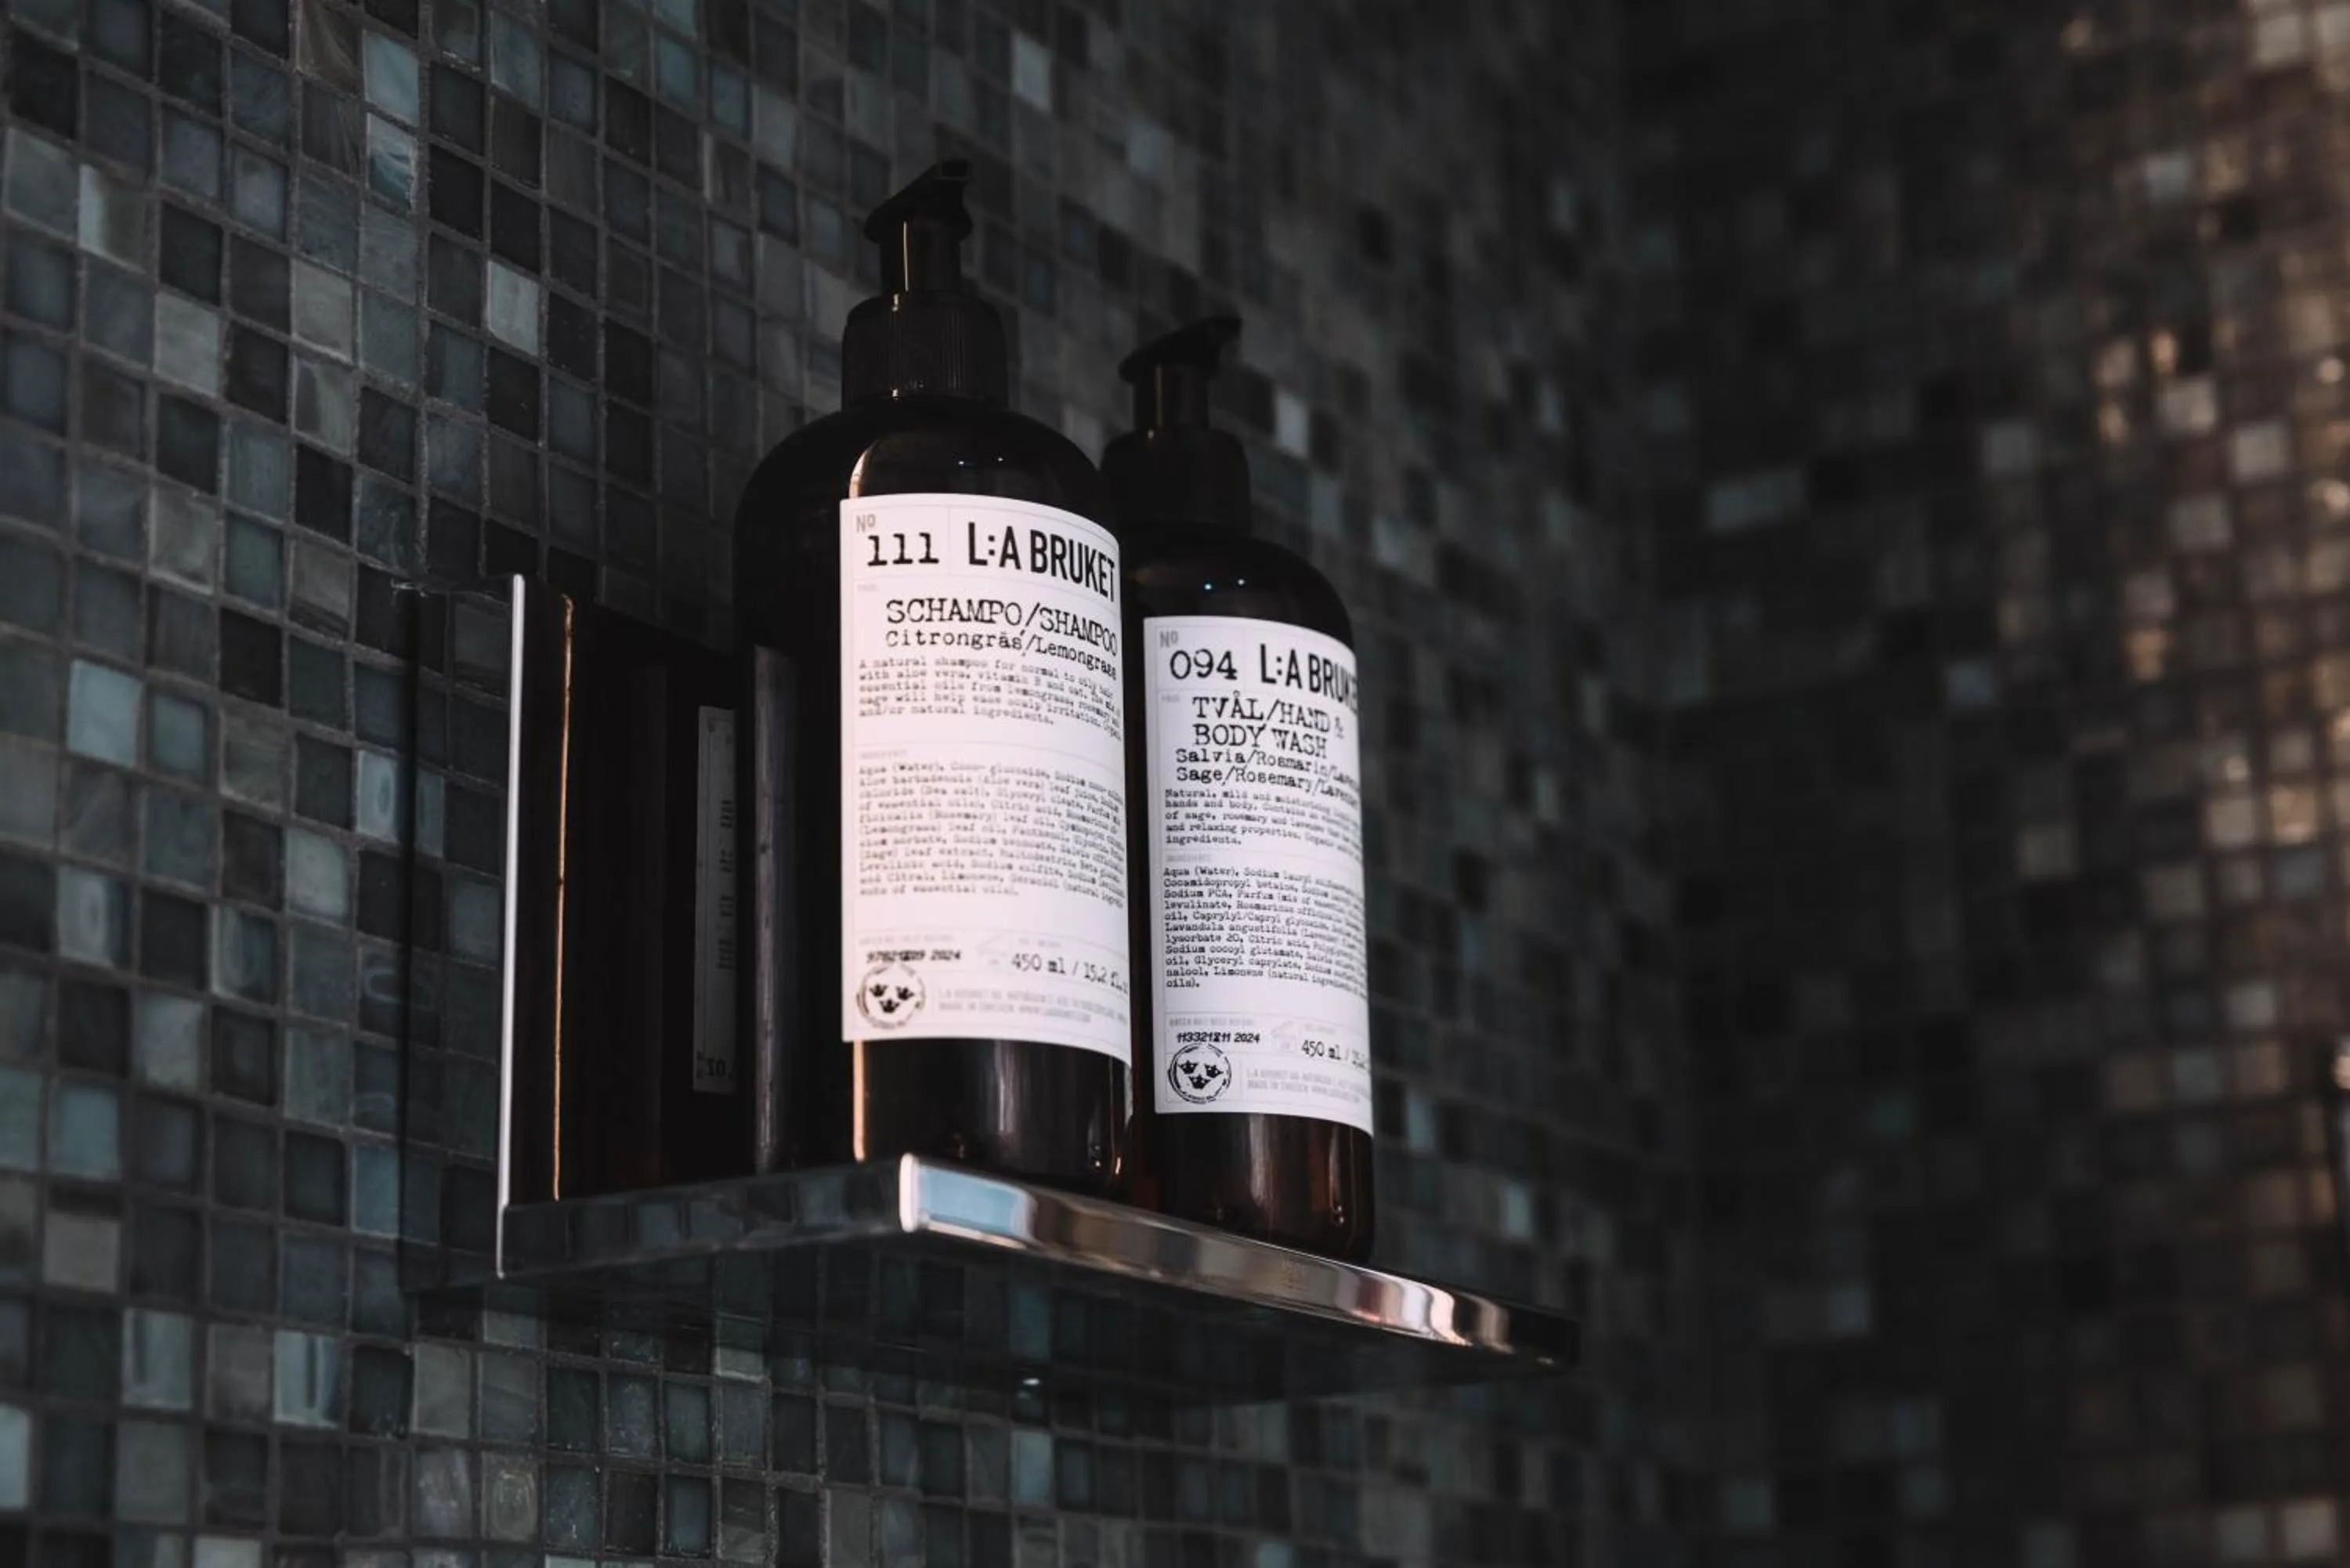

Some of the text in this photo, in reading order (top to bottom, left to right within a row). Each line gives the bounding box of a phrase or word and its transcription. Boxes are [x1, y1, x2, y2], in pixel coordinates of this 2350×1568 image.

[867, 532, 939, 566] 111
[967, 522, 1115, 602] L:A BRUKET
[886, 598, 1117, 657] SCHAMPO/SHAMPOO
[1170, 649, 1238, 681] 094
[1260, 643, 1303, 690] L:A
[1192, 724, 1328, 760] BODY WASH
[1010, 952, 1043, 973] 450
[1047, 956, 1067, 976] ml
[1234, 1031, 1261, 1043] 2024
[1300, 1039, 1325, 1057] 450
